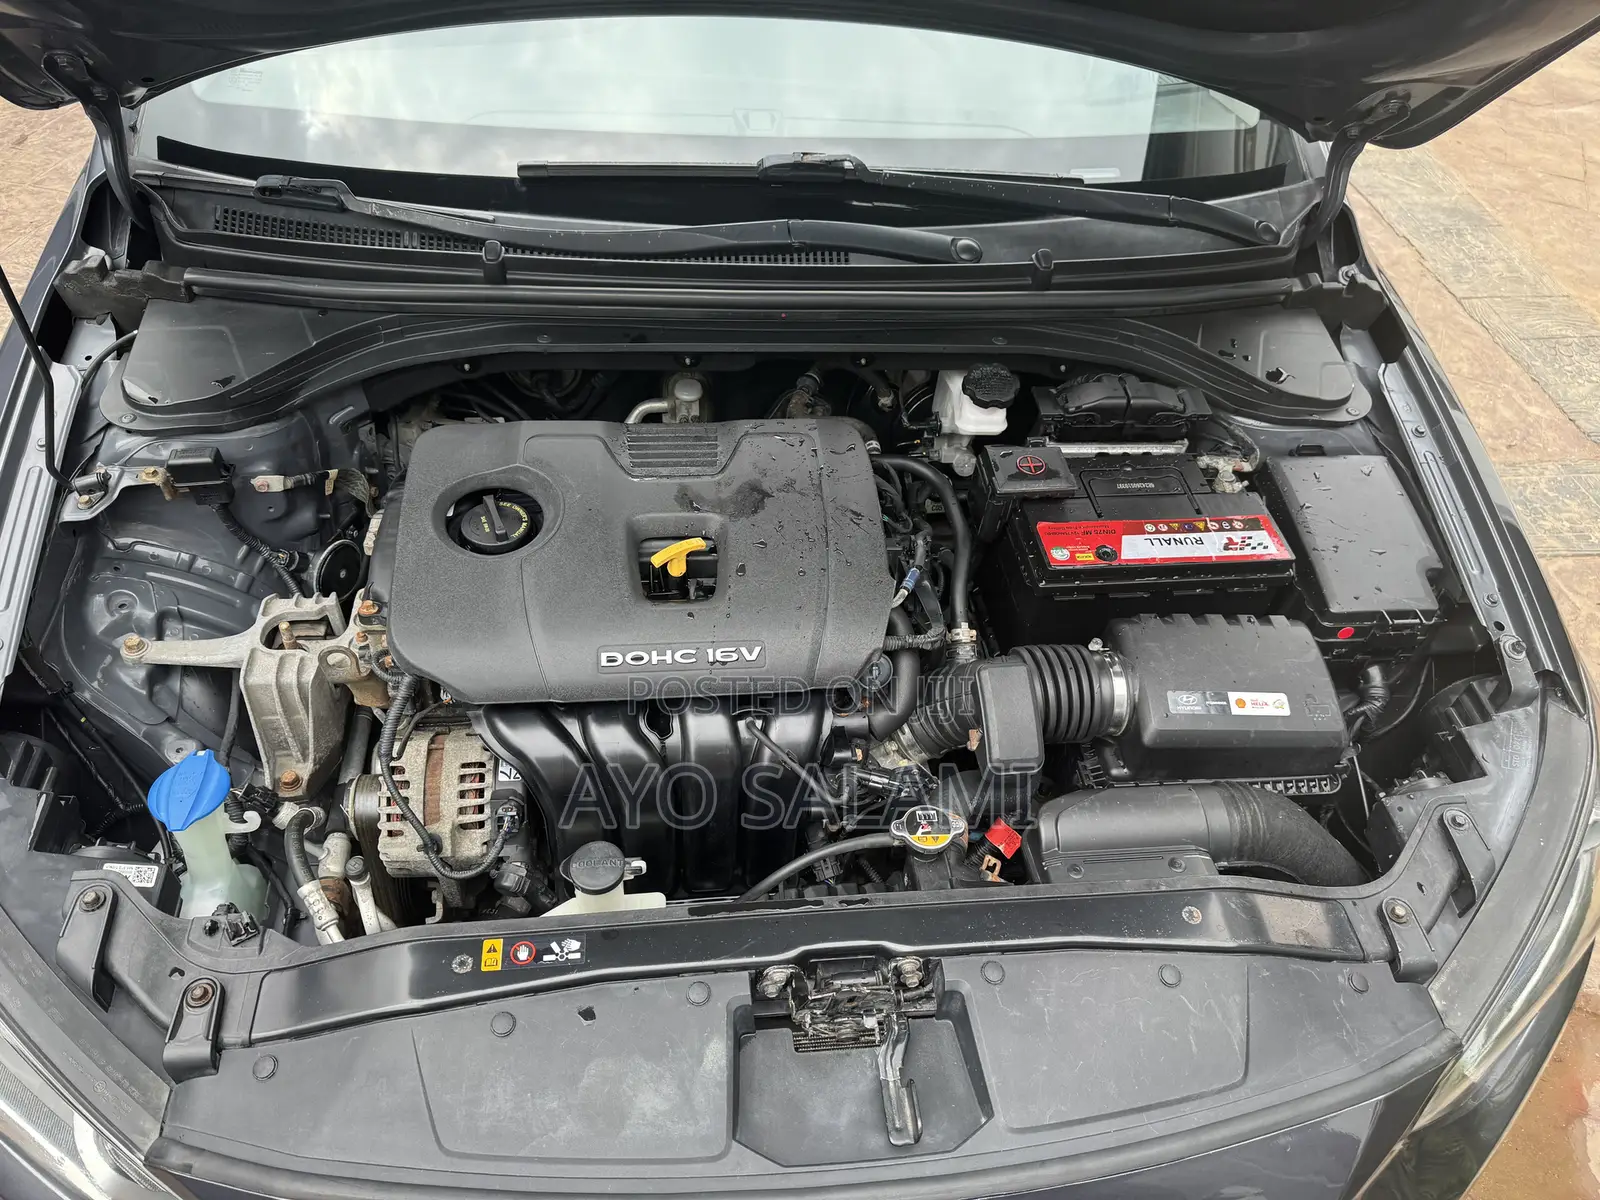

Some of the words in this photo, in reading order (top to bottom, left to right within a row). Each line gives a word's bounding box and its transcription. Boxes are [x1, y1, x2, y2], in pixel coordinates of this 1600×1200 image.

[1143, 536, 1204, 547] RUNALL
[599, 647, 698, 667] DOHC
[706, 645, 763, 664] 16V
[572, 857, 624, 868] COOLANT
